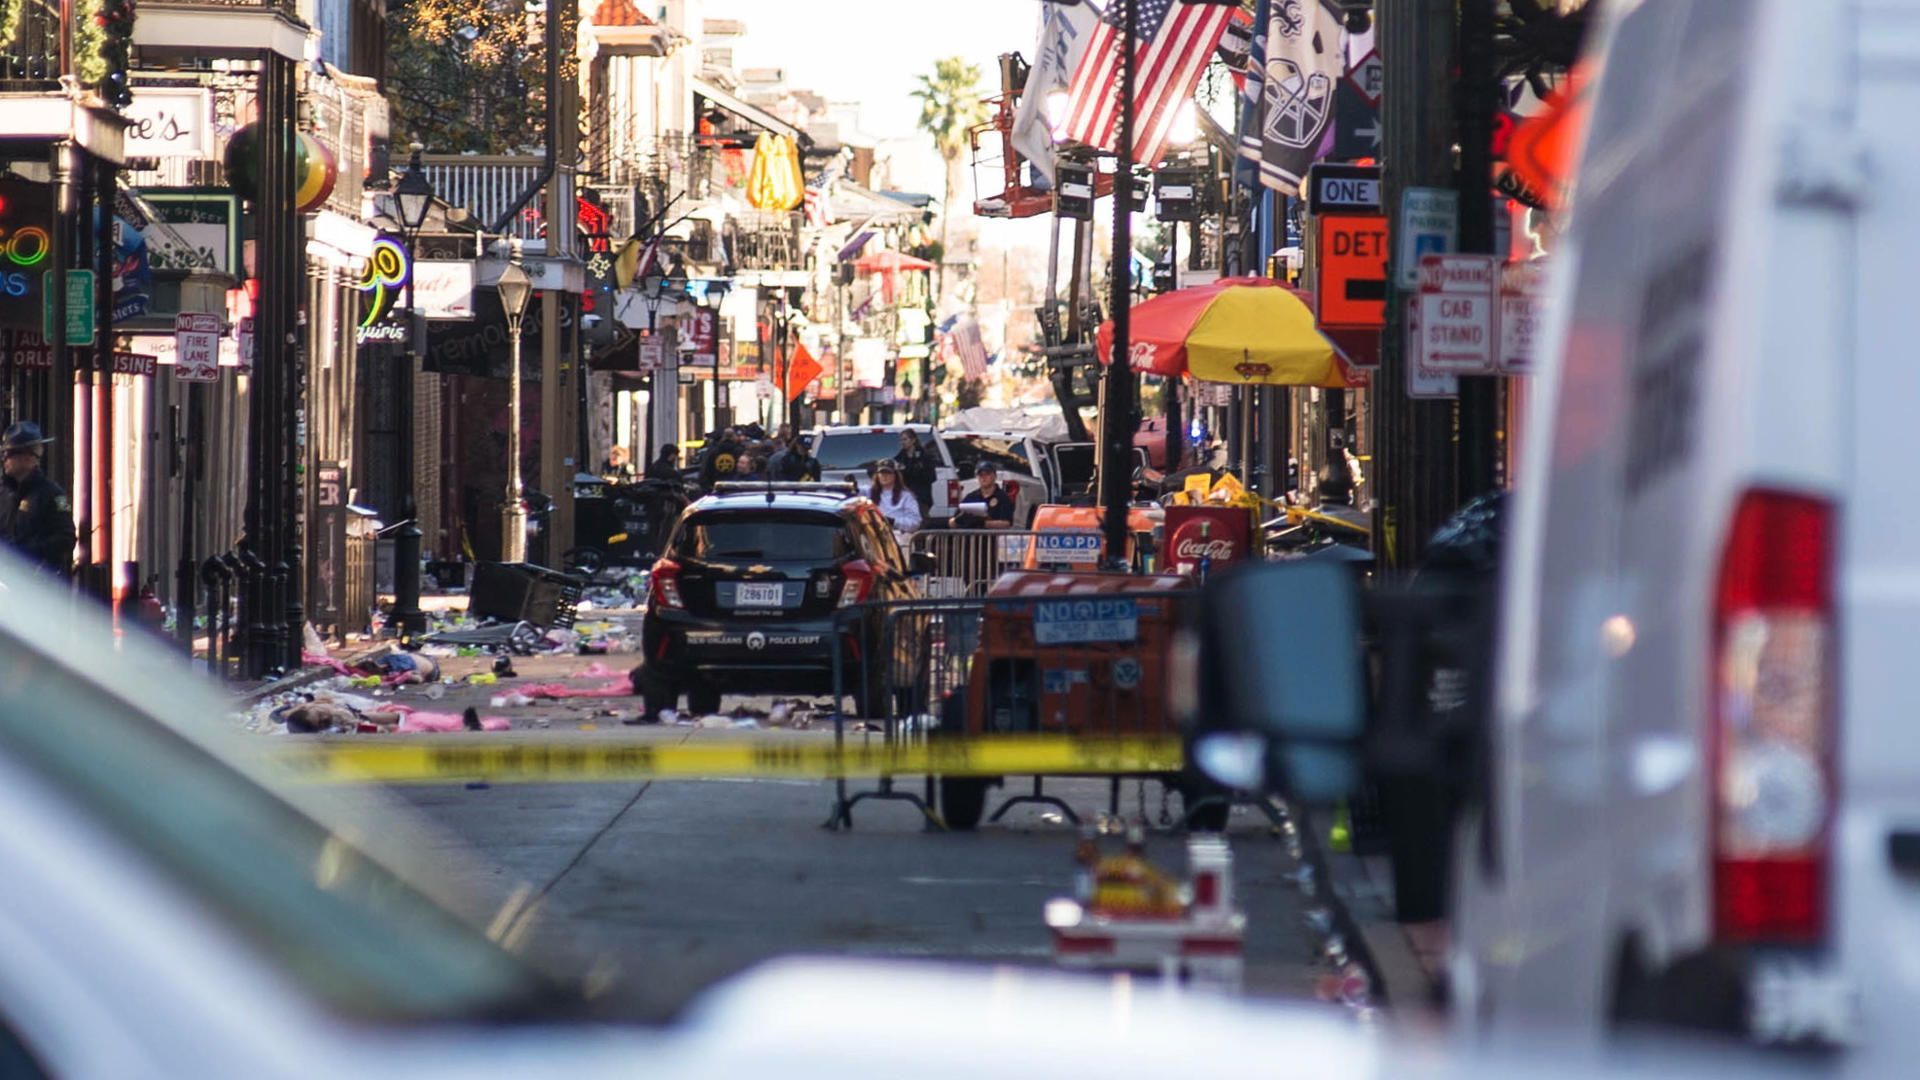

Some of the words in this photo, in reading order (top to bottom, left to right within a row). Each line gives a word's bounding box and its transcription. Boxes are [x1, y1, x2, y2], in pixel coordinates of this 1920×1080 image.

[1326, 181, 1369, 202] ONE
[1441, 300, 1473, 318] CAB
[178, 316, 192, 330] NO
[186, 335, 209, 348] FIRE
[1430, 326, 1482, 343] STAND
[184, 351, 210, 362] LANE
[768, 635, 797, 645] POLICE
[798, 635, 820, 645] DEPT
